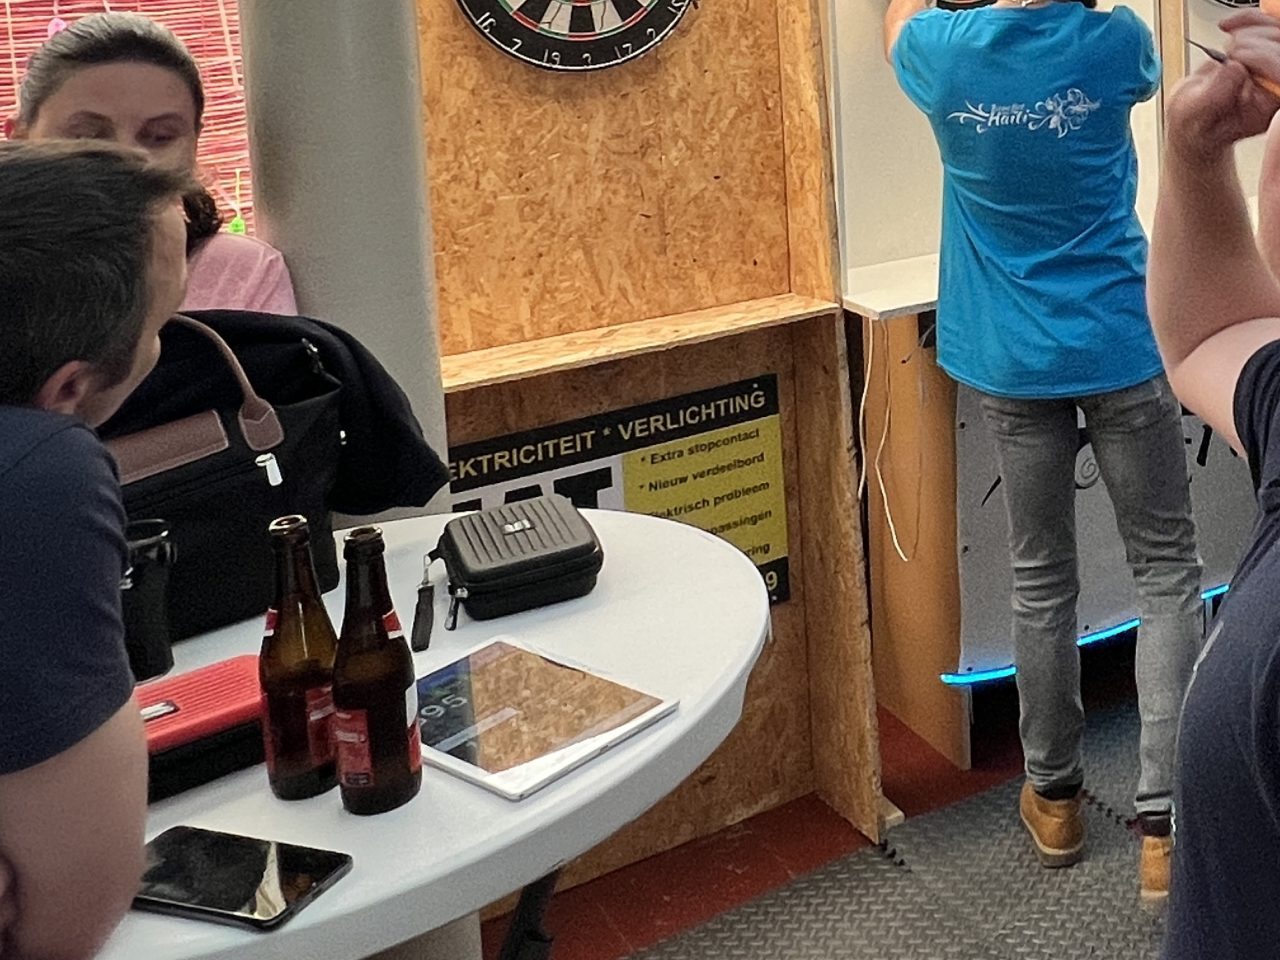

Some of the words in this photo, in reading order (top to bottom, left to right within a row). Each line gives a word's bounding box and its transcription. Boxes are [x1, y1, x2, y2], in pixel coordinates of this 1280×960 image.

[618, 389, 766, 440] VERLICHTING
[648, 475, 688, 492] Nieuw
[692, 451, 765, 480] verdeelbord
[651, 449, 684, 465] Extra
[713, 481, 770, 507] probleem
